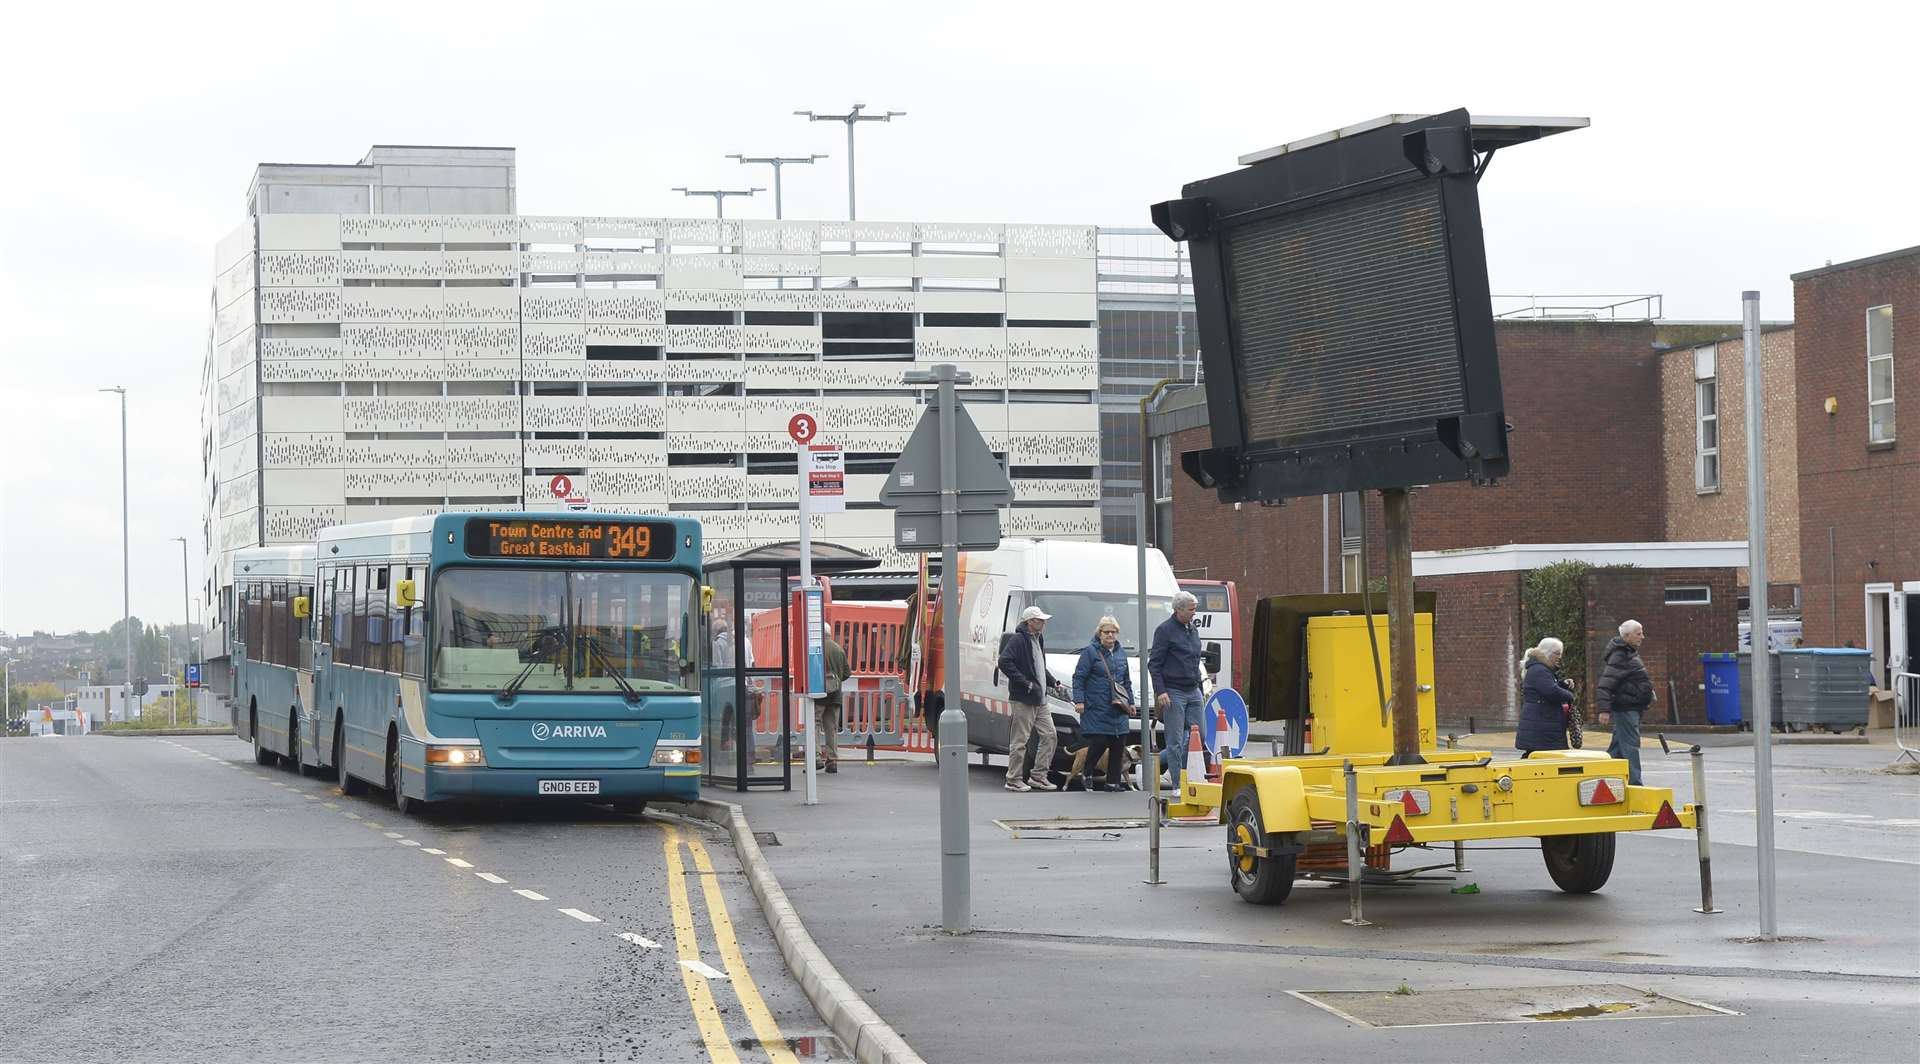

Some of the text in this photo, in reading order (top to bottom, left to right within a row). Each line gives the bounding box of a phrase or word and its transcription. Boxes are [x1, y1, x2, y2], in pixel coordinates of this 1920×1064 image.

[796, 419, 809, 438] 3
[555, 479, 566, 493] 4
[489, 523, 602, 539] Town Centre and
[500, 541, 591, 556] Great Easthall
[607, 526, 651, 557] 349
[1193, 614, 1212, 627] ell
[552, 725, 607, 738] ARRIVA
[543, 782, 596, 793] GN06 EEB
